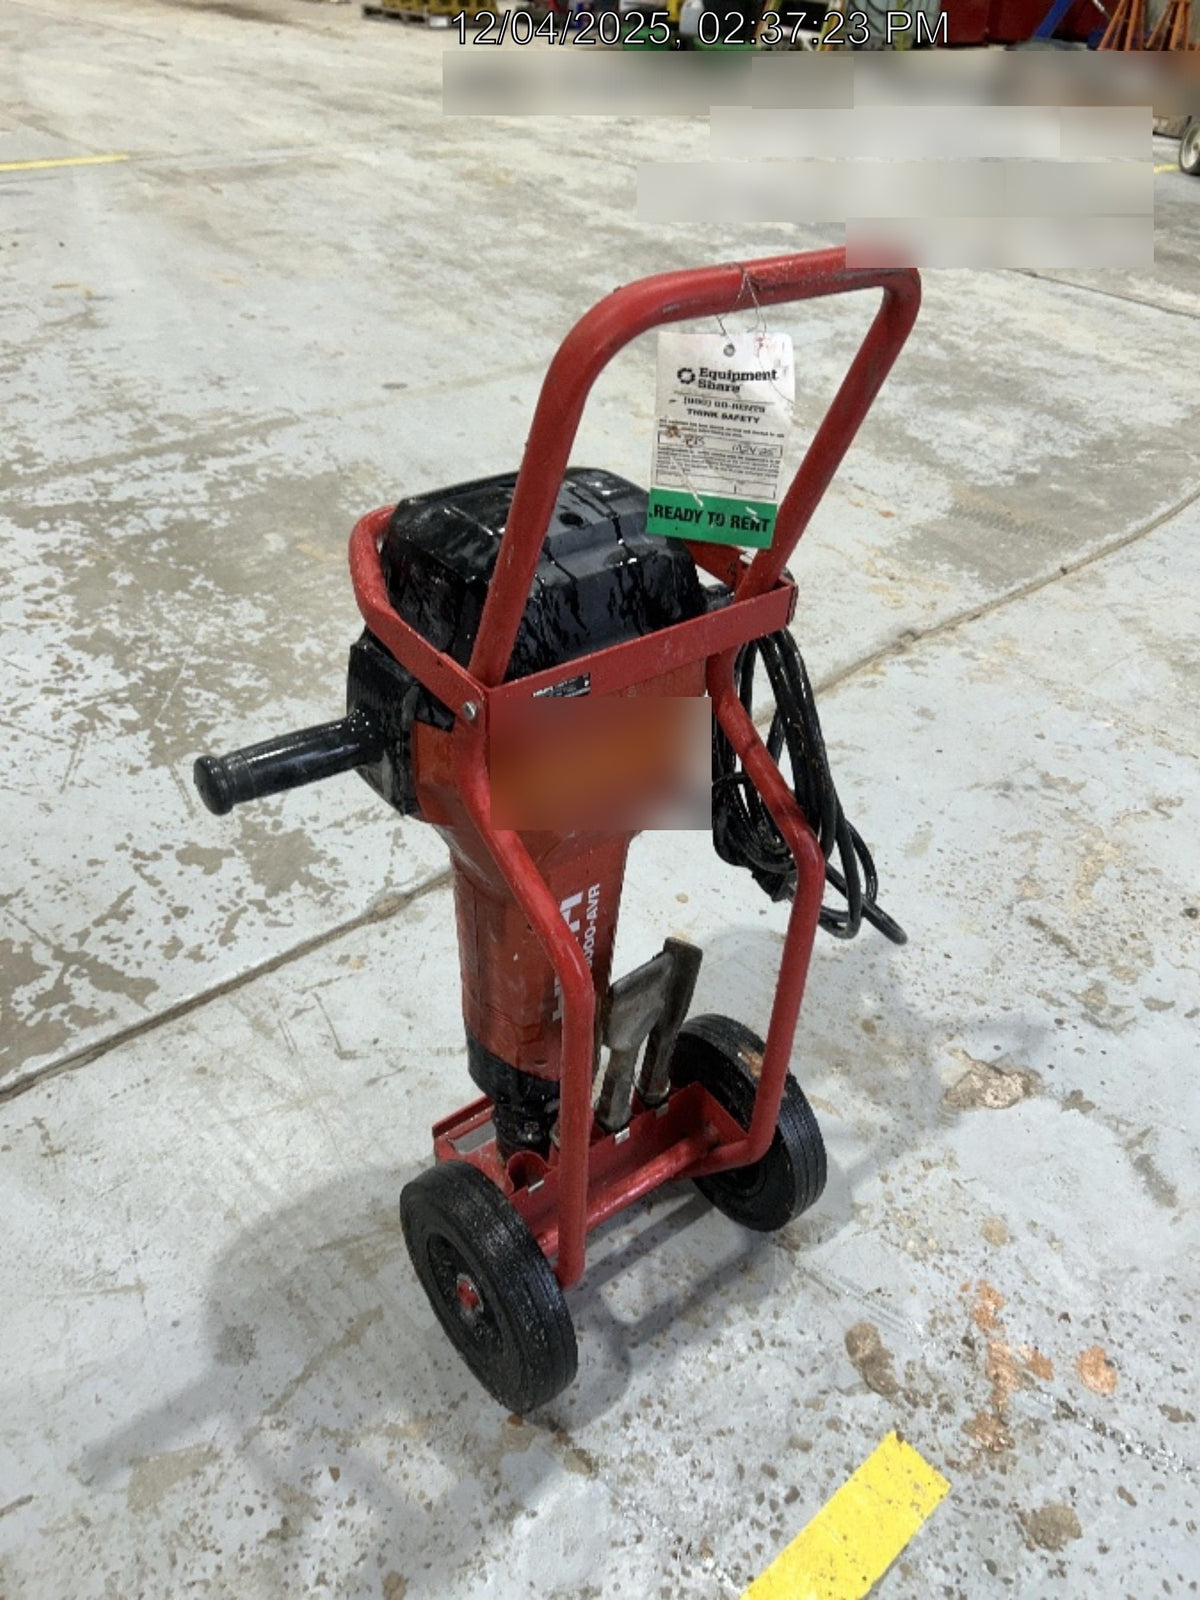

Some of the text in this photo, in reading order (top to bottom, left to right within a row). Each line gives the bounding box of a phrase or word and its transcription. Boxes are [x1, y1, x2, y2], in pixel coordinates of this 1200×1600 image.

[699, 367, 778, 383] Equipment
[698, 379, 741, 394] Share
[687, 408, 761, 424] THINK SAFETY
[653, 504, 771, 532] READY TO RENT
